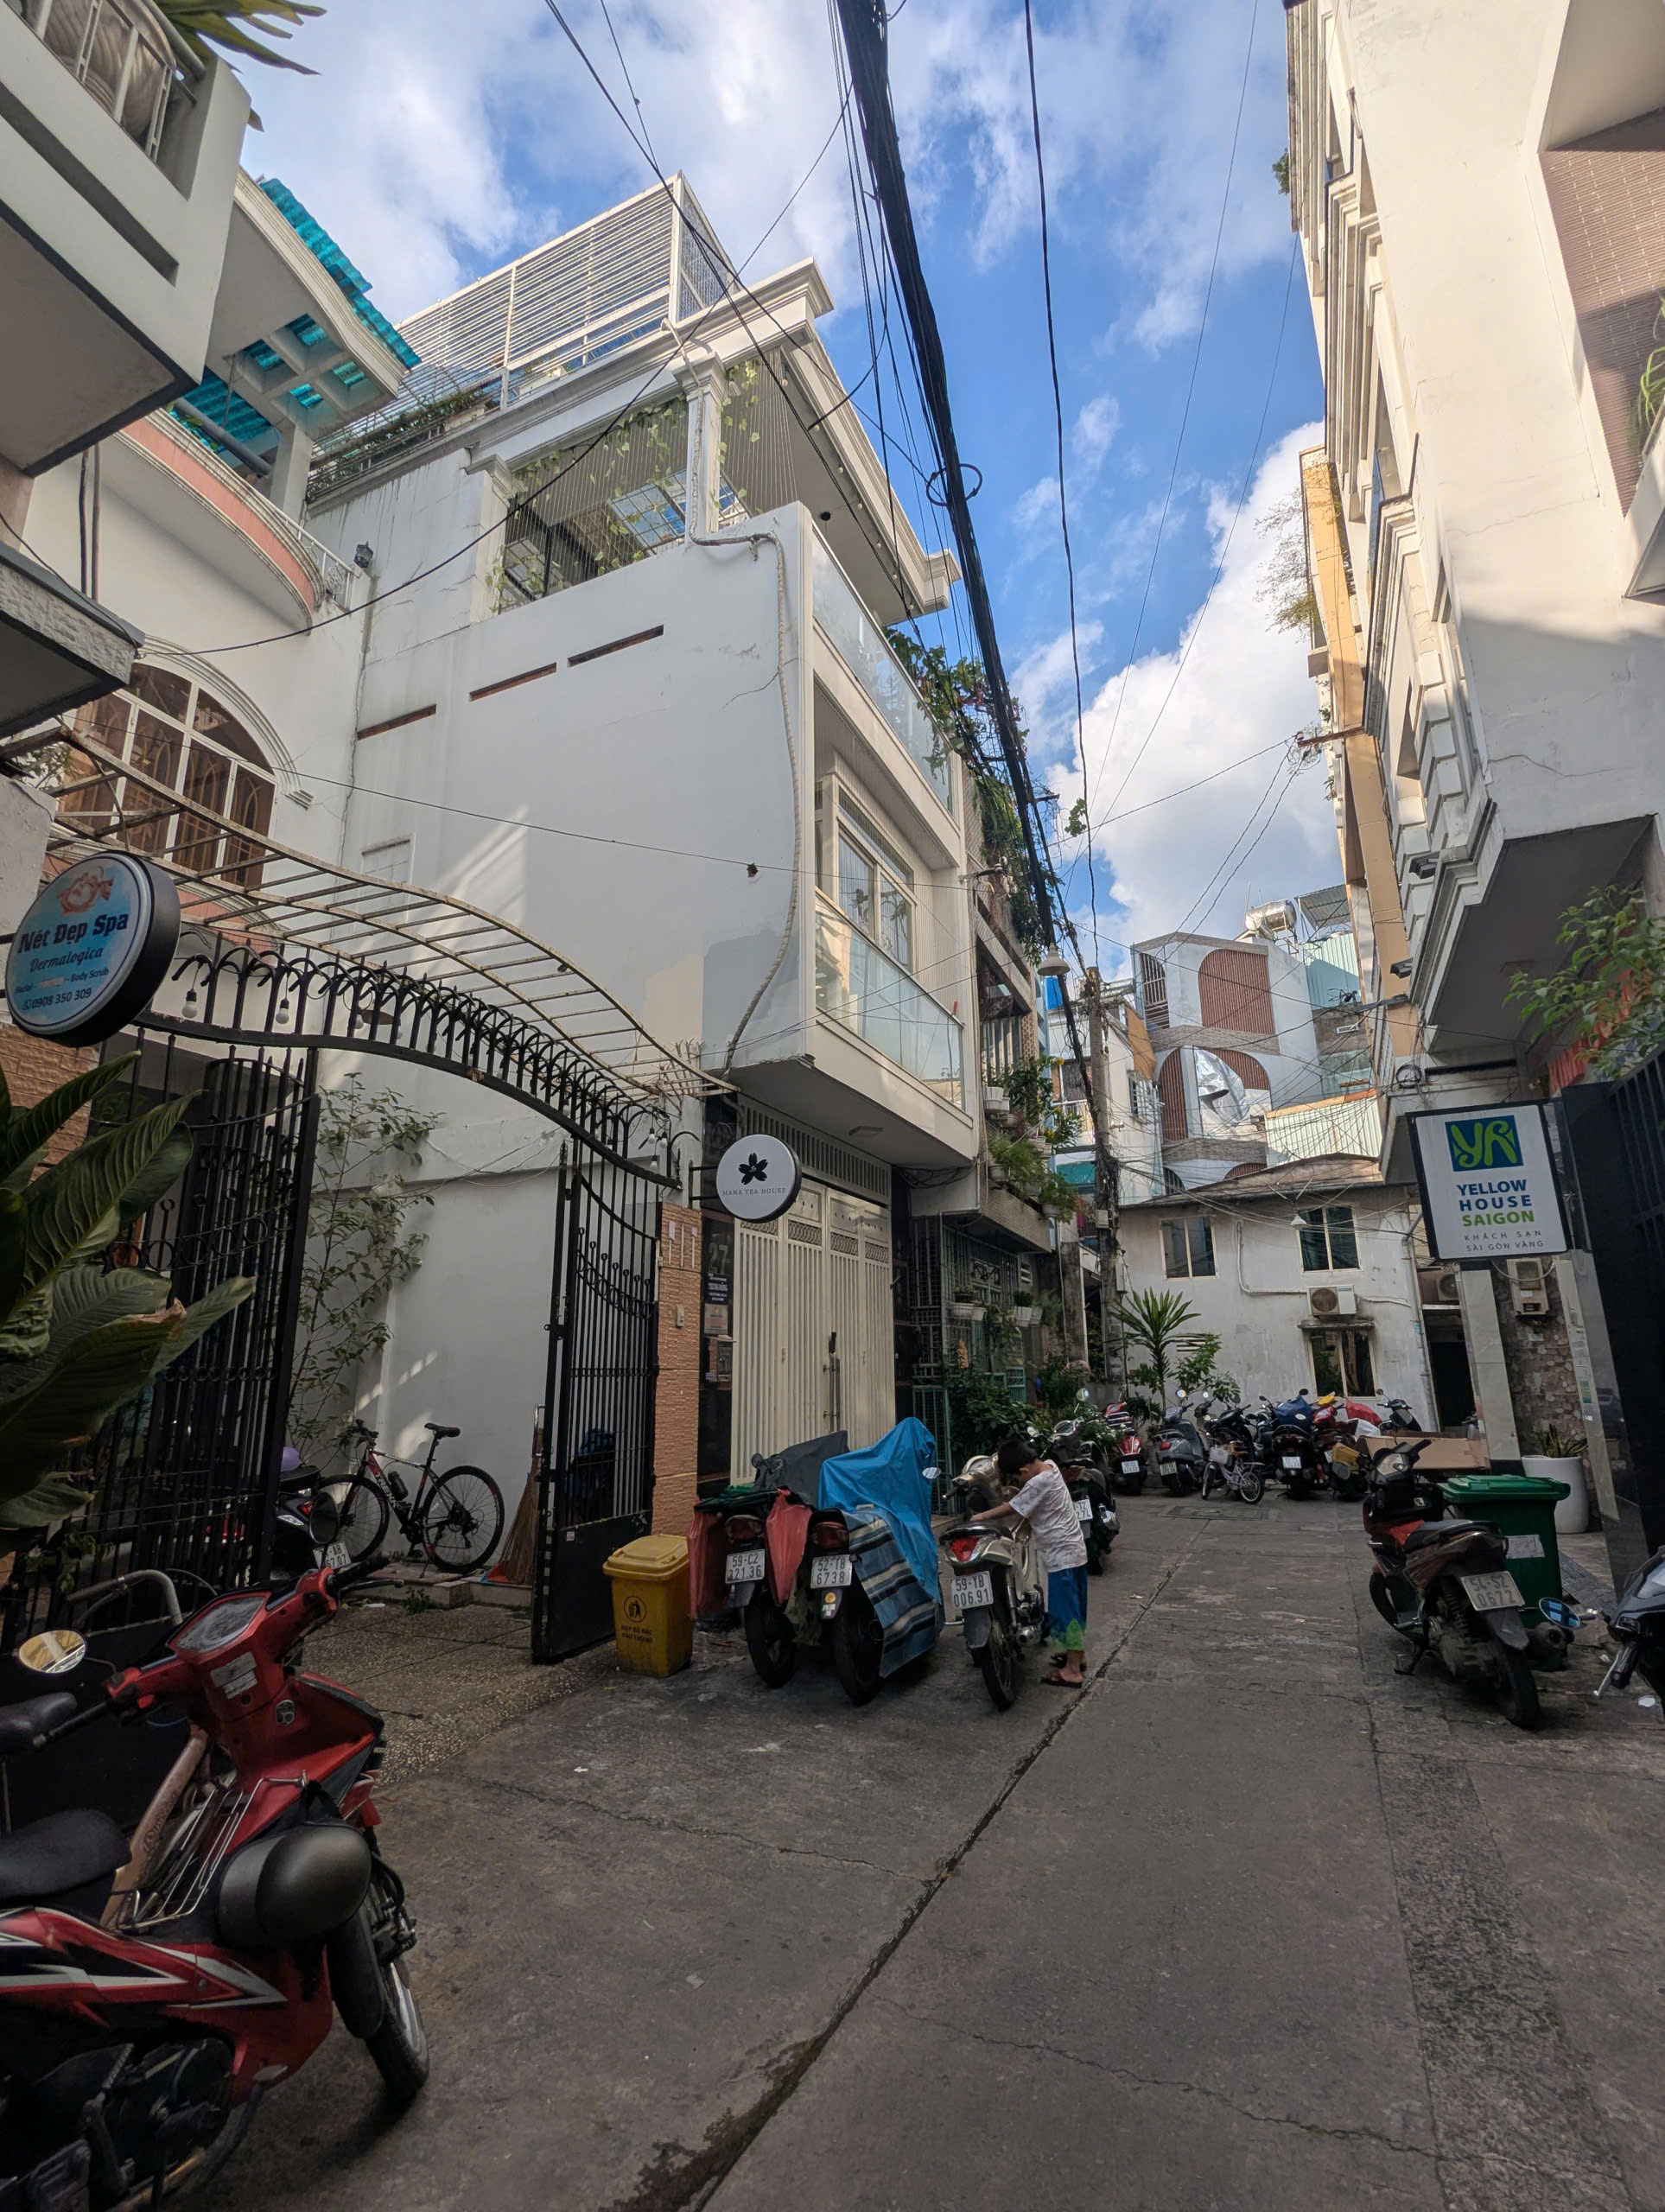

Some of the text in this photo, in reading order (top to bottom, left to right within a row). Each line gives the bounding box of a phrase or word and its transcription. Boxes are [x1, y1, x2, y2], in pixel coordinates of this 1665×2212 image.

[17, 930, 50, 953] Nét
[92, 912, 129, 938] Spa
[30, 947, 104, 972] Dermalogica
[88, 967, 110, 979] Scrub
[31, 988, 92, 1009] 0908 350 309
[1457, 1179, 1527, 1196] YELLOW
[1459, 1195, 1532, 1211] HOUSE
[1462, 1211, 1535, 1227] SAIGON
[817, 1571, 845, 1586] 6738
